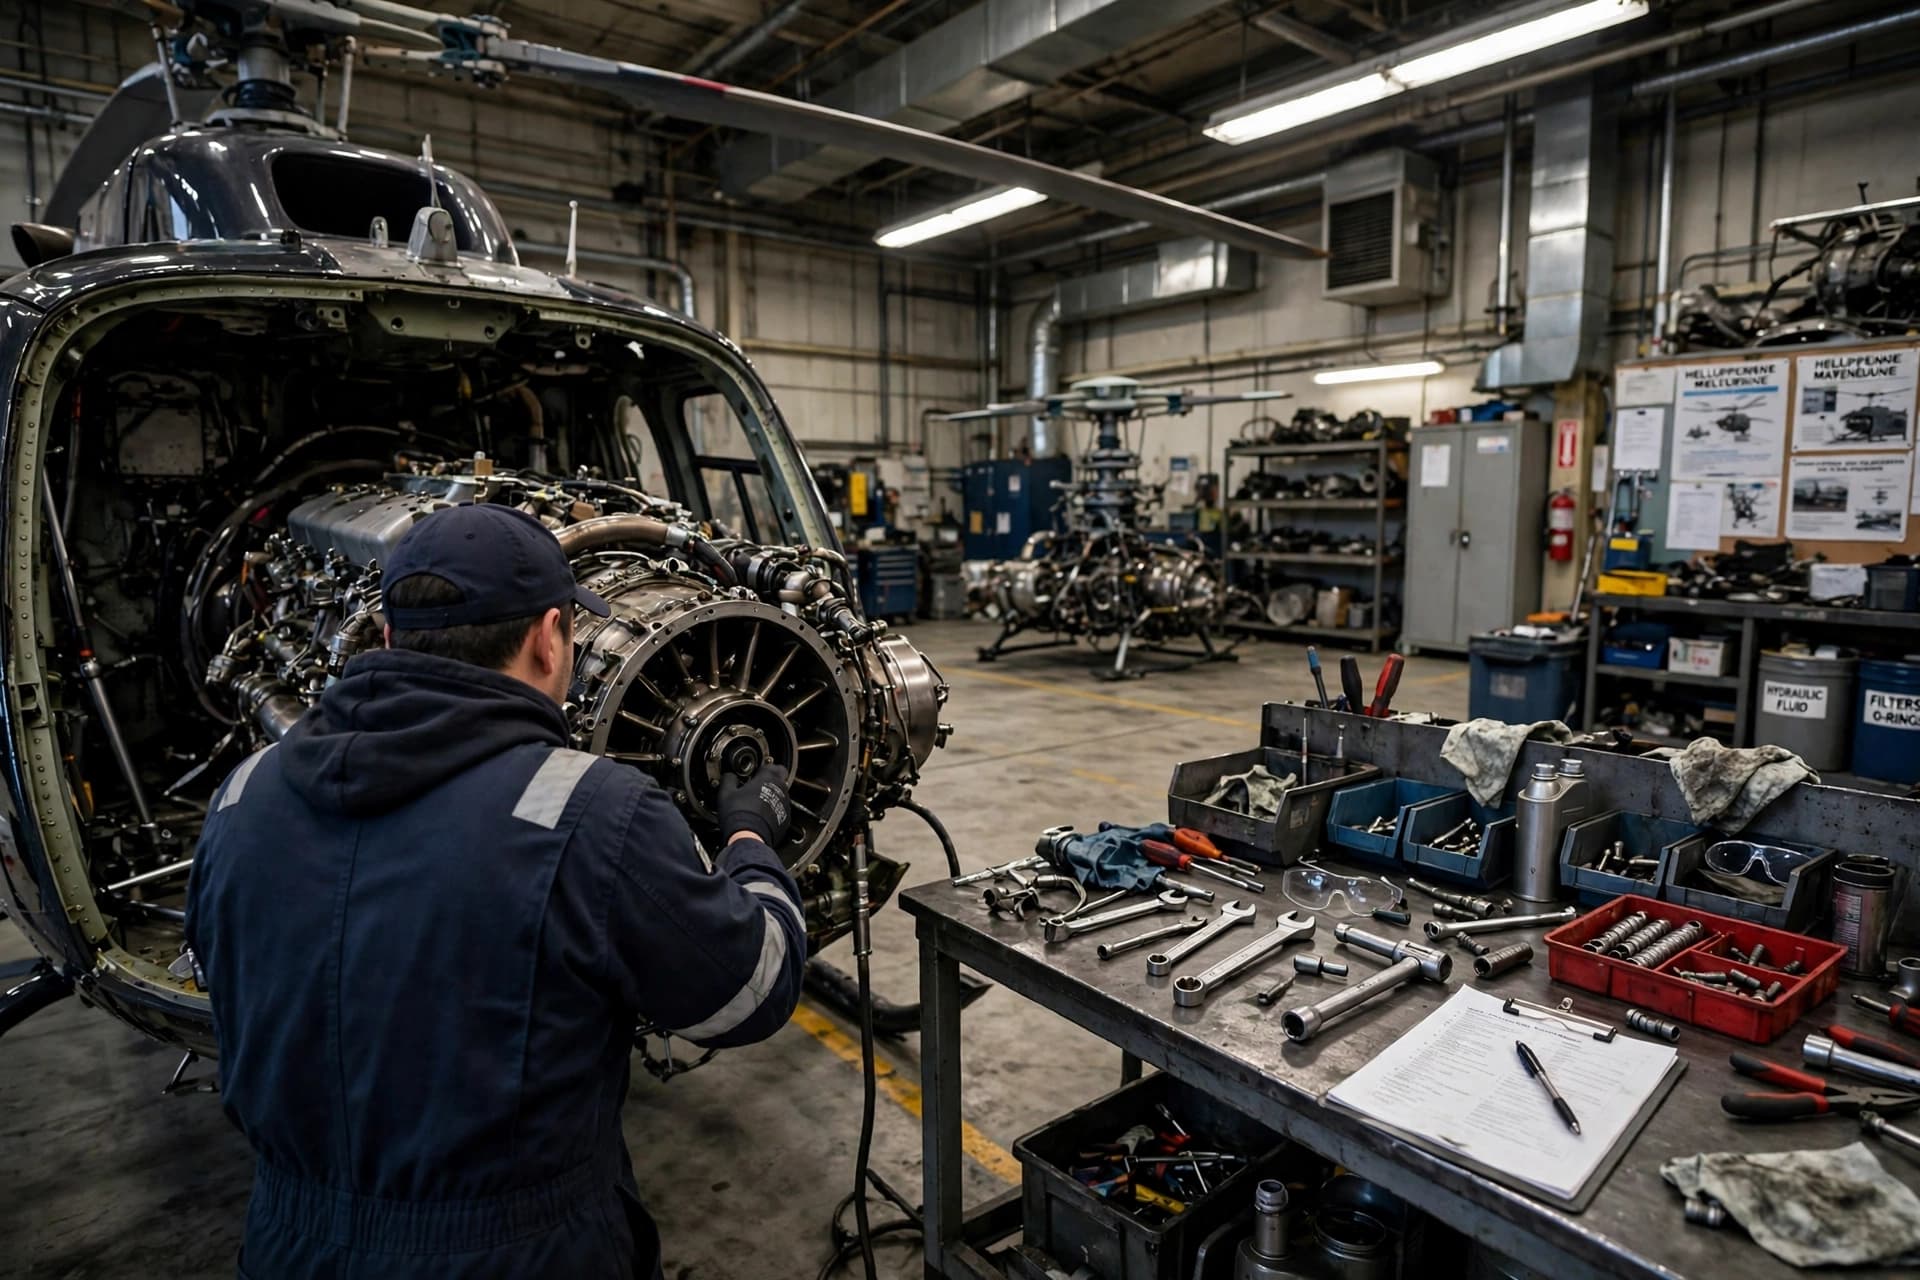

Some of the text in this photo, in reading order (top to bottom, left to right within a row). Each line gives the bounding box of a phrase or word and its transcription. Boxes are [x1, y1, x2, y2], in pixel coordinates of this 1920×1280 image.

[1767, 686, 1824, 700] HYDRAULIC
[1776, 700, 1807, 713] FLUID
[1871, 695, 1920, 711] FILTERS
